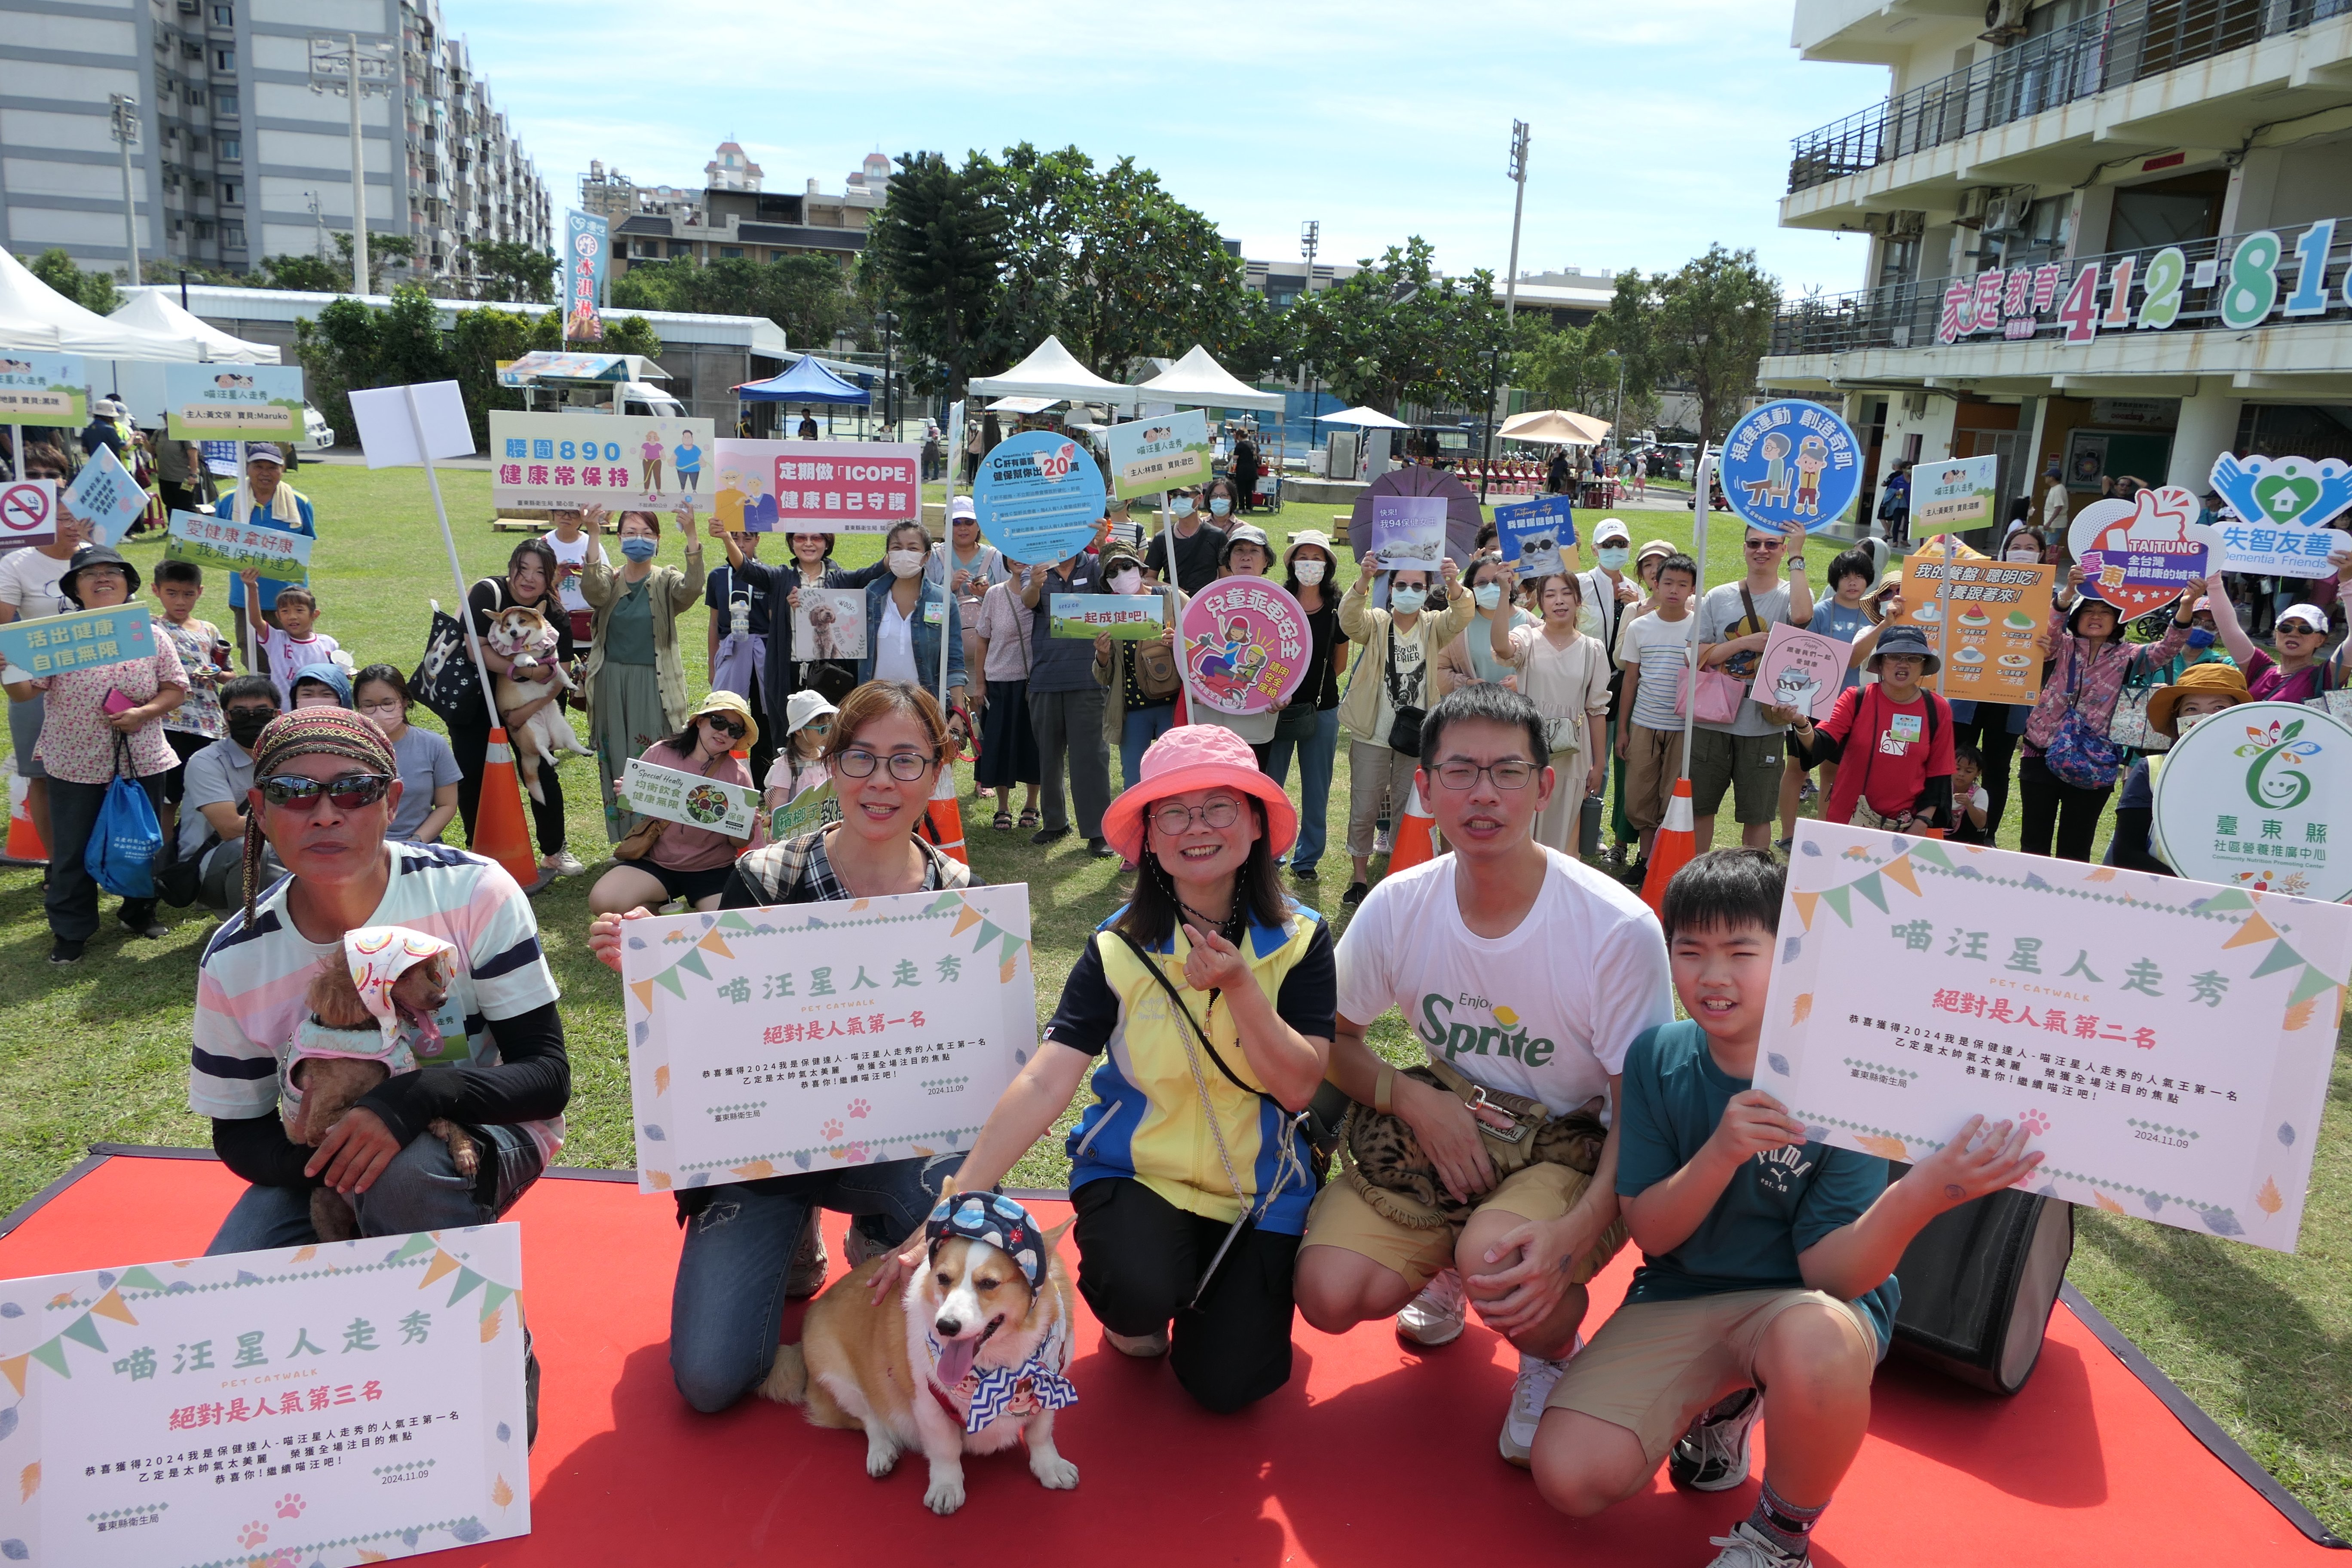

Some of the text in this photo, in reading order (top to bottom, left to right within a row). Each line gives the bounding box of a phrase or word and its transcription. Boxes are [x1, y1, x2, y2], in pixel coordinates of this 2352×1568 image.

[575, 257, 594, 318] 冰淇淋
[1937, 218, 2352, 345] 家庭教育 412-81
[204, 390, 268, 400] 喵汪星人走秀
[237, 411, 288, 420] 寶貝:Maruko
[1137, 438, 1182, 455] 喵汪星人走秀
[1730, 407, 1853, 471] 規律運動 創造奇肌
[505, 438, 622, 462] 腰圍890
[499, 464, 630, 487] 健康常保持
[1131, 457, 1194, 477] 主人:林意庭 寶貝:歐巴
[1935, 482, 1973, 496] 喵汪星人走秀
[780, 490, 907, 511] 健康自己守護
[1380, 508, 1397, 517] 快來!
[1507, 514, 1564, 530] 我是保健帥哥
[1380, 518, 1437, 529] 我94保健女王
[186, 519, 294, 554] 愛健康 拿好康
[2223, 526, 2333, 558] 失智友善
[2128, 539, 2202, 555] TAITUNG
[196, 542, 302, 573] 我是保健達人
[2282, 554, 2327, 569] Friends
[2079, 551, 2164, 588] 臺東 全台灣
[2127, 567, 2200, 581] 最健康的城市
[1070, 610, 1148, 623] 一起成健吧!
[1204, 587, 1302, 662] 兒童乘車安全
[27, 619, 115, 648] 活出健康
[33, 640, 120, 671] 自信無限
[1786, 646, 1831, 661] 跟著我們一起
[1796, 658, 1818, 668] 愛健康
[1268, 660, 1290, 678] 請用
[1265, 671, 1284, 689] 安全
[1256, 682, 1278, 699] 座椅
[638, 769, 662, 781] Special
[635, 779, 682, 798] 均衡飲食
[632, 791, 680, 810] 健康無限
[728, 812, 745, 823] 保健
[778, 802, 819, 831] 檳榔子
[2216, 815, 2328, 845] 臺東縣
[2214, 839, 2326, 861] 社區營養推廣中心
[2212, 854, 2245, 863] Community
[2273, 859, 2304, 868] Promoting
[1891, 918, 2231, 1009] 喵汪星人走秀
[717, 953, 963, 1006] 喵汪星人走秀
[1989, 977, 2092, 1003] PET CATWALK
[801, 998, 876, 1014] PET CATWALK
[1459, 992, 1493, 1011] Enjoy
[762, 1010, 927, 1046] 絕對是人氣第一名
[1931, 987, 2157, 1050] 絕對是人氣第二名
[1418, 993, 1555, 1068] Sprite
[423, 1038, 438, 1053] 2
[743, 1052, 951, 1085] 乙定是太帥氣太美麗 榮獲全場注目的焦點
[1850, 1067, 1908, 1089] 臺東縣衛生局
[1895, 1036, 2180, 1106] 乙定是太帥氣太美麗 榮獲全場注目的焦點
[928, 1084, 964, 1096] 2024.11.09
[714, 1109, 761, 1123] 臺東縣衛生局
[2135, 1129, 2190, 1149] 2024.11.09
[1778, 1183, 1788, 1192] 48
[1008, 1224, 1024, 1251] ふじさん
[112, 1309, 433, 1383] 喵汪星人走秀
[221, 1367, 318, 1389] PET CATWALK
[168, 1378, 384, 1433] 絕對是人氣第三名
[138, 1431, 413, 1484] 乙定是太帥氣太美麗 榮獲全場注目的焦點
[382, 1468, 429, 1486] 2024.11.09
[96, 1513, 159, 1533] 臺東縣衛生局
